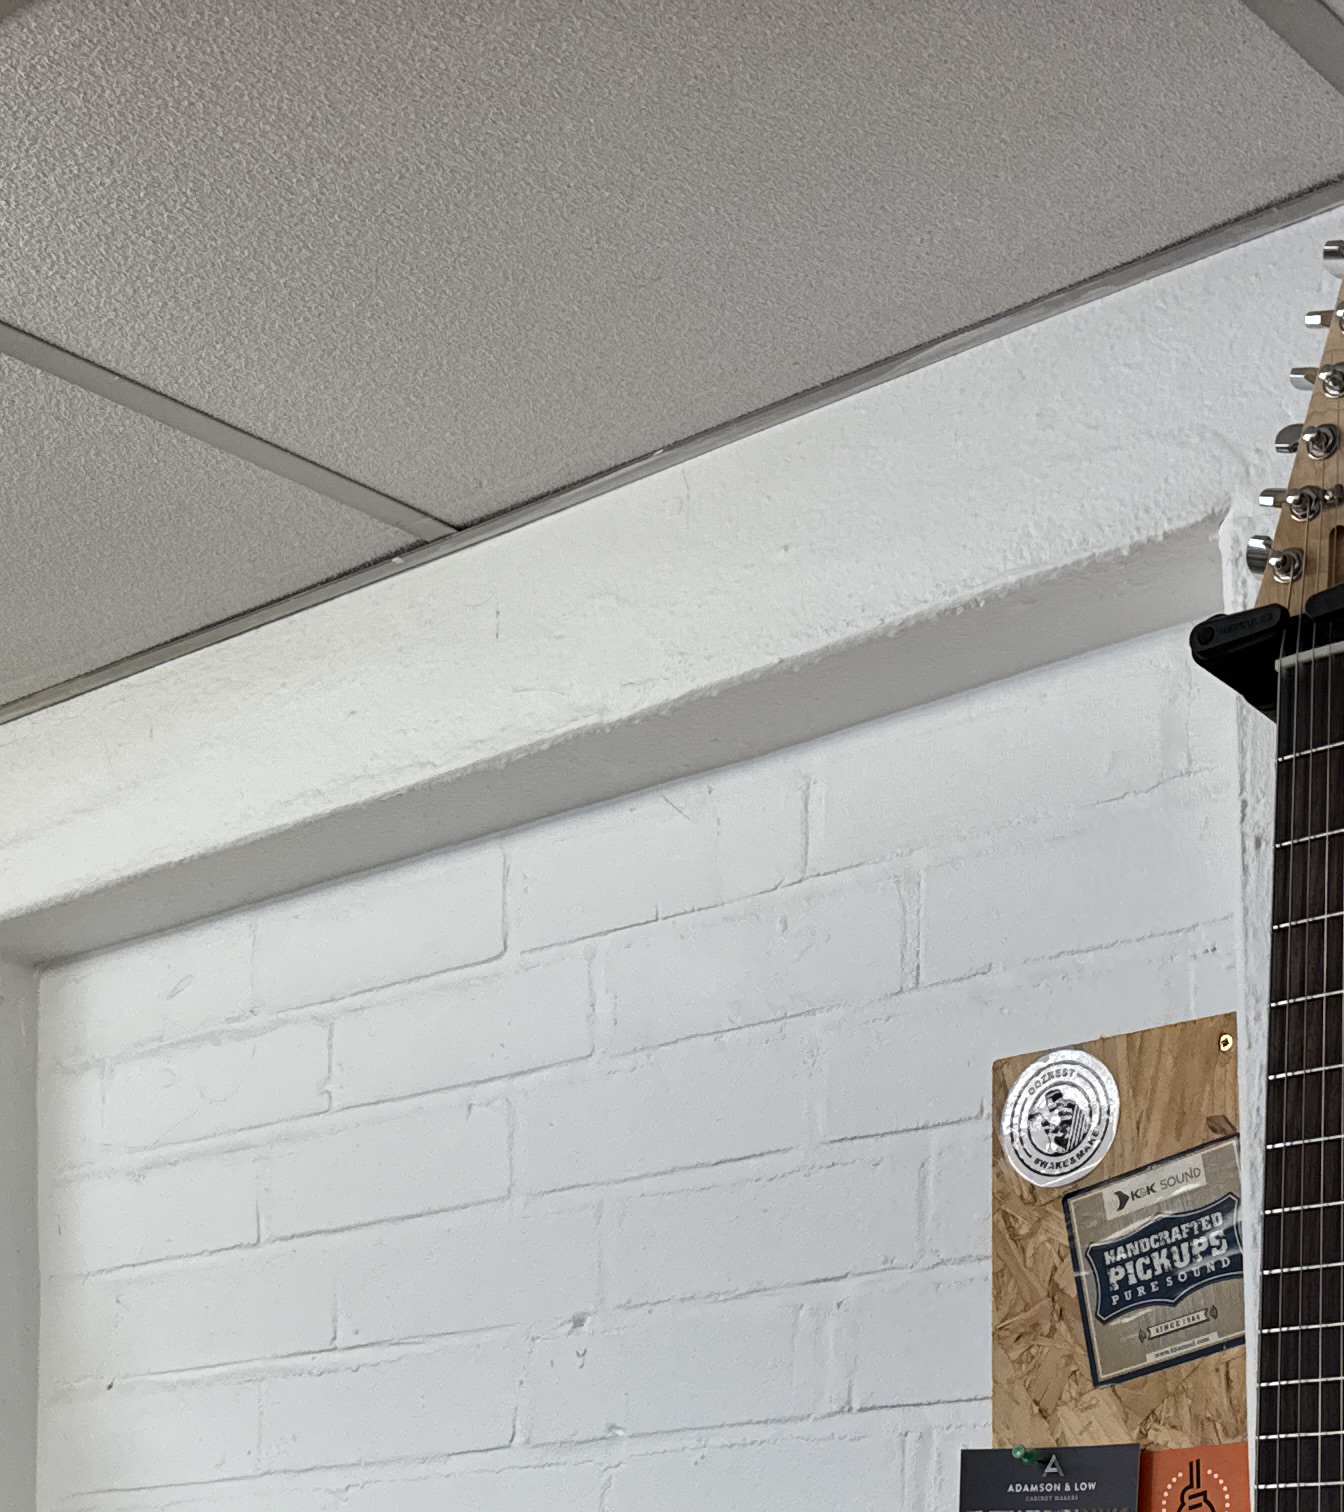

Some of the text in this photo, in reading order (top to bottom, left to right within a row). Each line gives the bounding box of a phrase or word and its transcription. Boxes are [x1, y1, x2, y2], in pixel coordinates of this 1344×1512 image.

[1159, 1166, 1202, 1191] SOUND
[1103, 1211, 1224, 1266] HANDCRAFTED
[1108, 1228, 1230, 1292] PICKUPS
[1111, 1256, 1232, 1306] PURE SOUND
[1155, 1320, 1181, 1334] SINCE
[1007, 1481, 1097, 1493] ADAMSON & LOW
